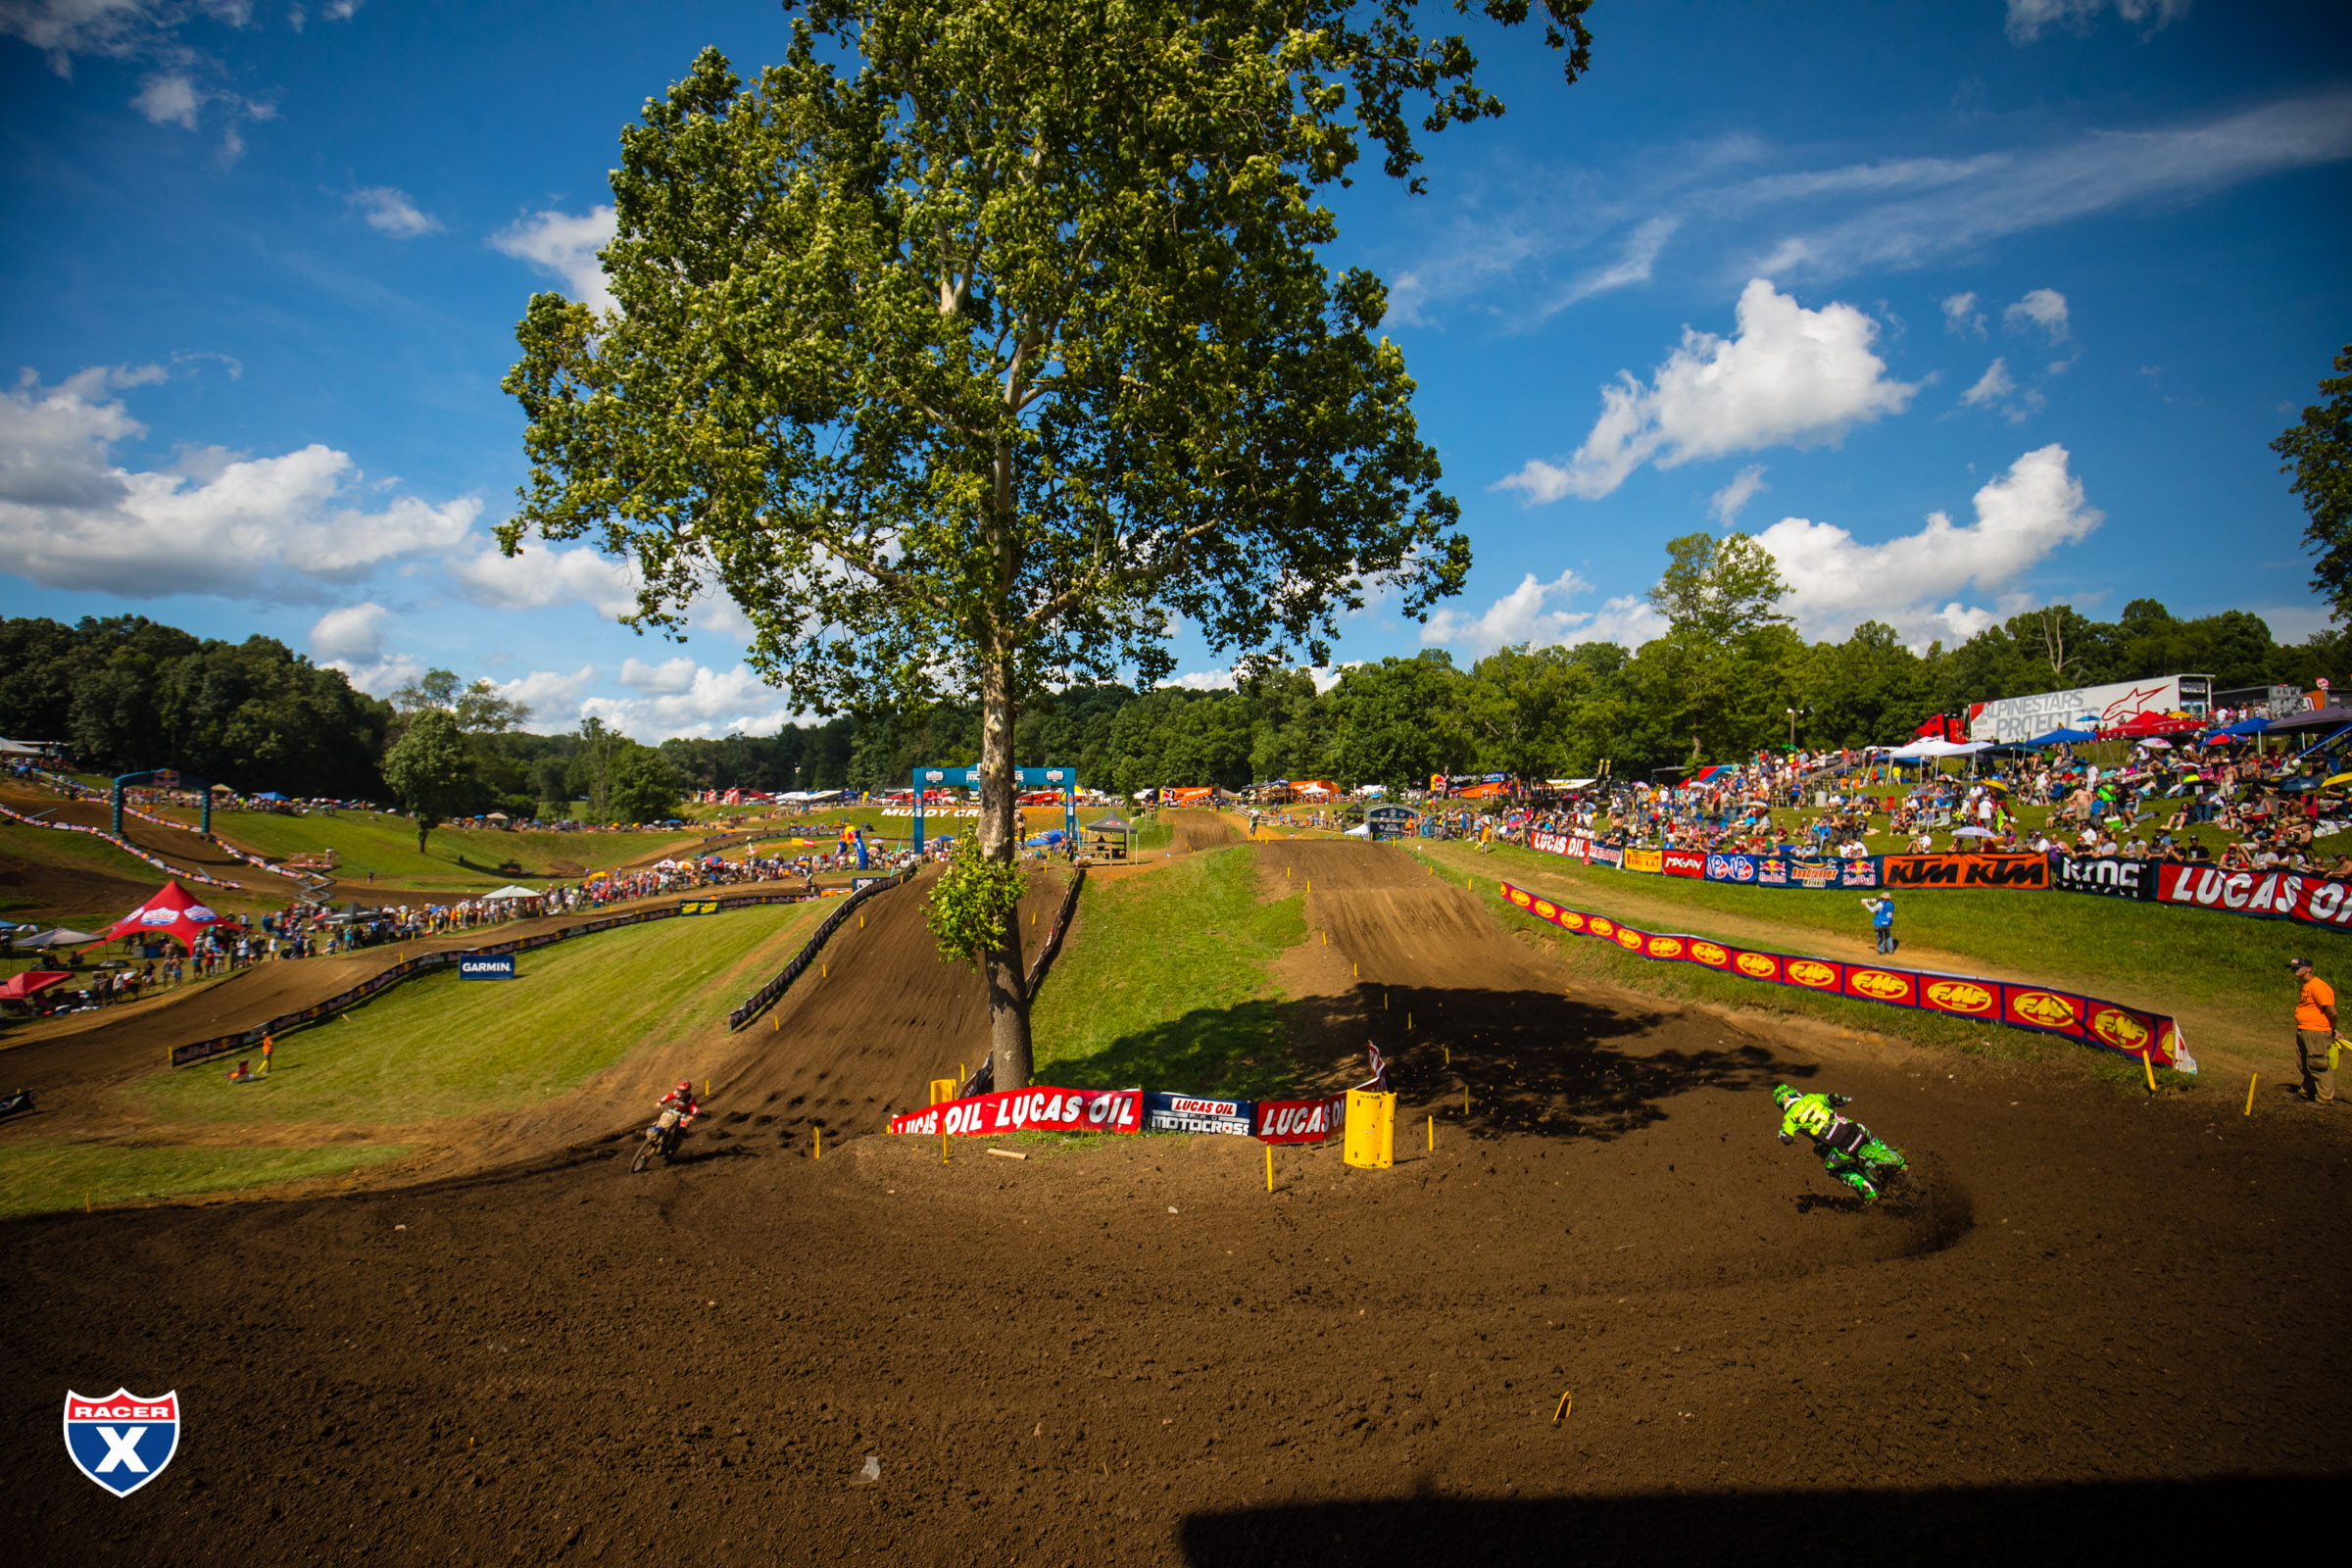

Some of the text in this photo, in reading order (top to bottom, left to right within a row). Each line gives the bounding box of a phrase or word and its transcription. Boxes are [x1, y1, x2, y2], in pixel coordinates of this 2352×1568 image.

[1981, 690, 2084, 719] ALPINESTARS
[881, 808, 951, 817] MUDY
[1535, 833, 1586, 858] LUCAS OIL
[1791, 867, 1838, 881] Roadrunner
[1842, 874, 1876, 886] Red Bull
[1887, 858, 2044, 884] KTM KTM
[2172, 866, 2352, 923] LUCAS OI
[462, 961, 510, 972] GARMIN
[1738, 955, 1775, 971] FMF
[1788, 963, 1835, 980] FMF
[1851, 974, 1906, 992] FMF
[1928, 985, 1990, 1004] FMF
[2014, 997, 2074, 1018] FMF
[2095, 1013, 2146, 1040] FMF
[944, 1102, 983, 1135] OIL
[995, 1093, 1135, 1127] LUCAS OIL
[1175, 1100, 1234, 1114] LUCAS OIL
[1261, 1099, 1346, 1136] LUCAS OI
[1799, 1102, 1831, 1136] 3
[1152, 1115, 1250, 1136] MOTOCROSS
